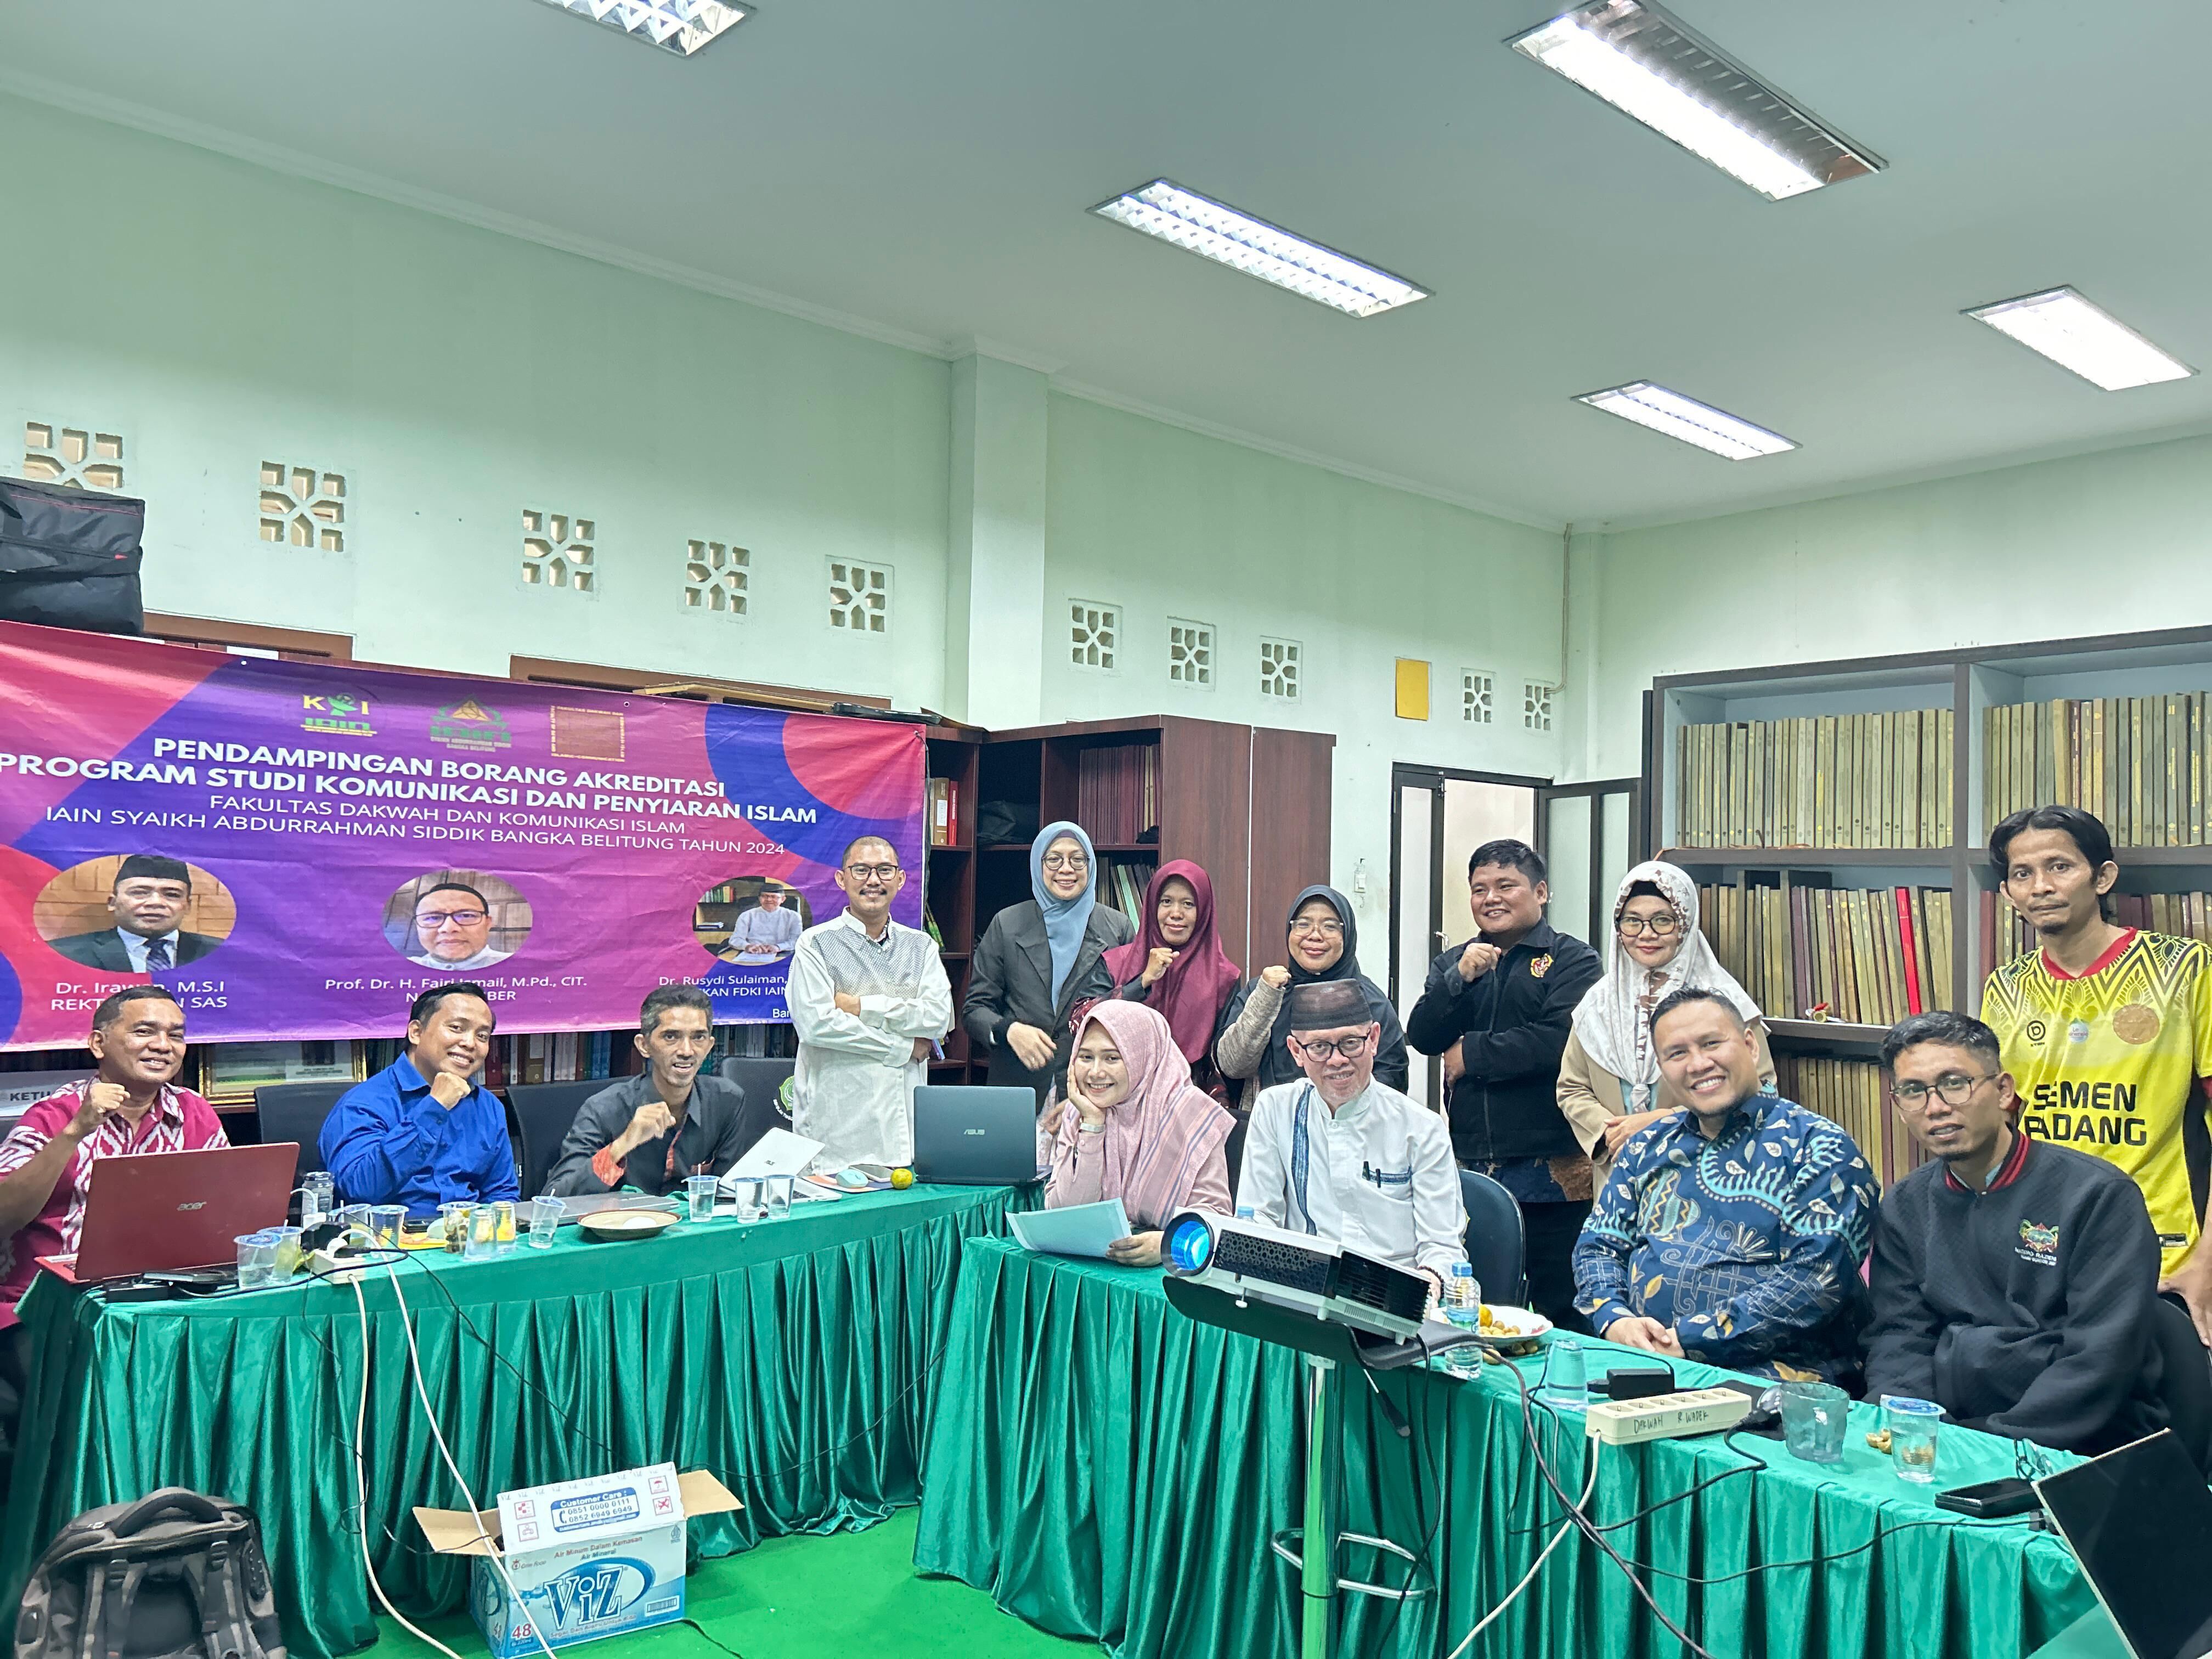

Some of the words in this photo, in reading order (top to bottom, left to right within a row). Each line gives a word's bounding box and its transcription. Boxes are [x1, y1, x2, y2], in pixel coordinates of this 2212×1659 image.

[154, 738, 432, 776] PENDAMPINGAN
[441, 760, 567, 786] BORANG
[573, 771, 724, 797] AKREDITASI
[0, 753, 196, 785] PROGRAM
[206, 768, 306, 792] STUDI
[315, 775, 517, 805] KOMUNIKASI
[526, 789, 585, 809] DAN
[594, 794, 740, 819] PENYIARAN
[747, 805, 816, 823] ISLAM
[210, 795, 331, 815] FAKULTAS
[340, 803, 438, 821] DAKWAH
[447, 809, 492, 823] DAN
[500, 812, 624, 831] KOMUNIKASI
[631, 820, 685, 833] ISLAM
[47, 806, 101, 823] IAIN
[110, 810, 205, 828] SYAIKH
[213, 815, 405, 837] ABDURRAHMAN
[413, 825, 484, 842] SIDDIK
[491, 830, 575, 845] BANGKA
[581, 834, 674, 850] BELITUNG
[679, 839, 741, 852] TAHUN
[746, 842, 785, 855] 2024
[57, 983, 87, 994] Dr.
[178, 981, 224, 992] M.S.I
[325, 979, 364, 990] Prof.
[370, 978, 393, 989] Dr.
[399, 978, 416, 989] H.
[511, 977, 556, 988] M.Pd.,
[561, 977, 587, 986] CIT.
[659, 977, 678, 986] Dr.
[683, 975, 724, 988] Rusydi
[728, 975, 788, 985] Sulaiman,
[733, 987, 761, 996] FDKI
[51, 998, 106, 1011] REKT
[190, 996, 227, 1008] SAS
[2033, 1081, 2137, 1112] SEMEN
[176, 1201, 207, 1211] acer
[1634, 1414, 1663, 1434] DAKWAH
[560, 1496, 600, 1508] Customer
[602, 1492, 622, 1500] Care
[568, 1506, 587, 1515] 0851
[612, 1498, 630, 1506] 0111
[569, 1514, 589, 1523] 0852
[590, 1543, 611, 1551] Dalam
[613, 1537, 642, 1546] Kemasan
[512, 1623, 532, 1639] 48
